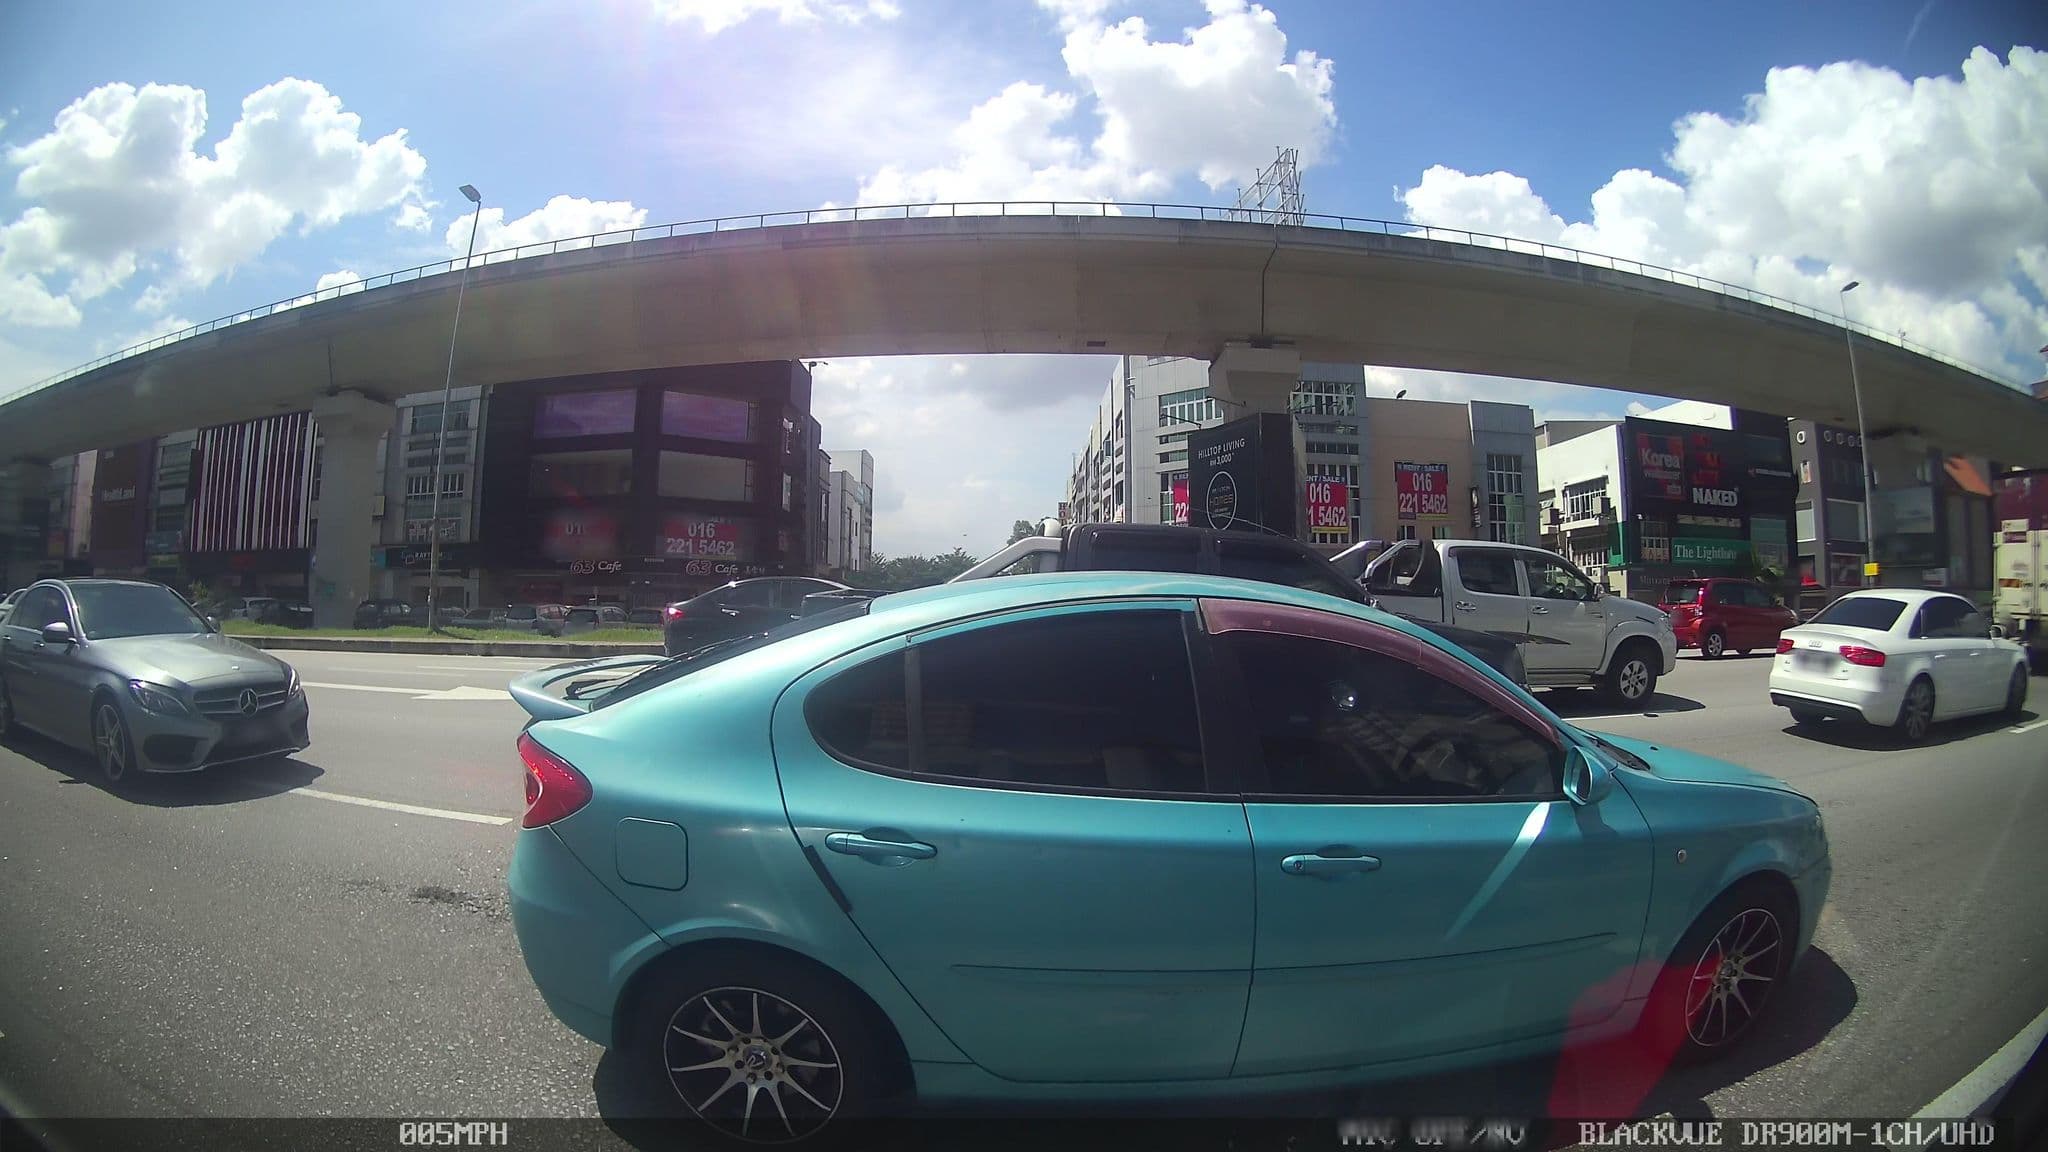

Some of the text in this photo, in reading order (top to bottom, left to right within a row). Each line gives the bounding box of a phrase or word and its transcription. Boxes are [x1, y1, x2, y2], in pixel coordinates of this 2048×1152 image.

[1198, 438, 1245, 460] HILLTOP LIVING
[1641, 448, 1681, 469] Korea
[1412, 472, 1433, 492] 016
[1310, 482, 1331, 504] 016
[1400, 493, 1447, 513] 221 5462
[1692, 488, 1738, 507] NAKED
[1175, 502, 1189, 523] 22
[1318, 505, 1347, 527] 5462
[687, 521, 716, 538] 016
[666, 537, 735, 556] 221 5462
[1674, 544, 1694, 558] The
[570, 559, 622, 575] 63 Cafe
[685, 560, 713, 576] 63
[715, 564, 739, 575] Cafe
